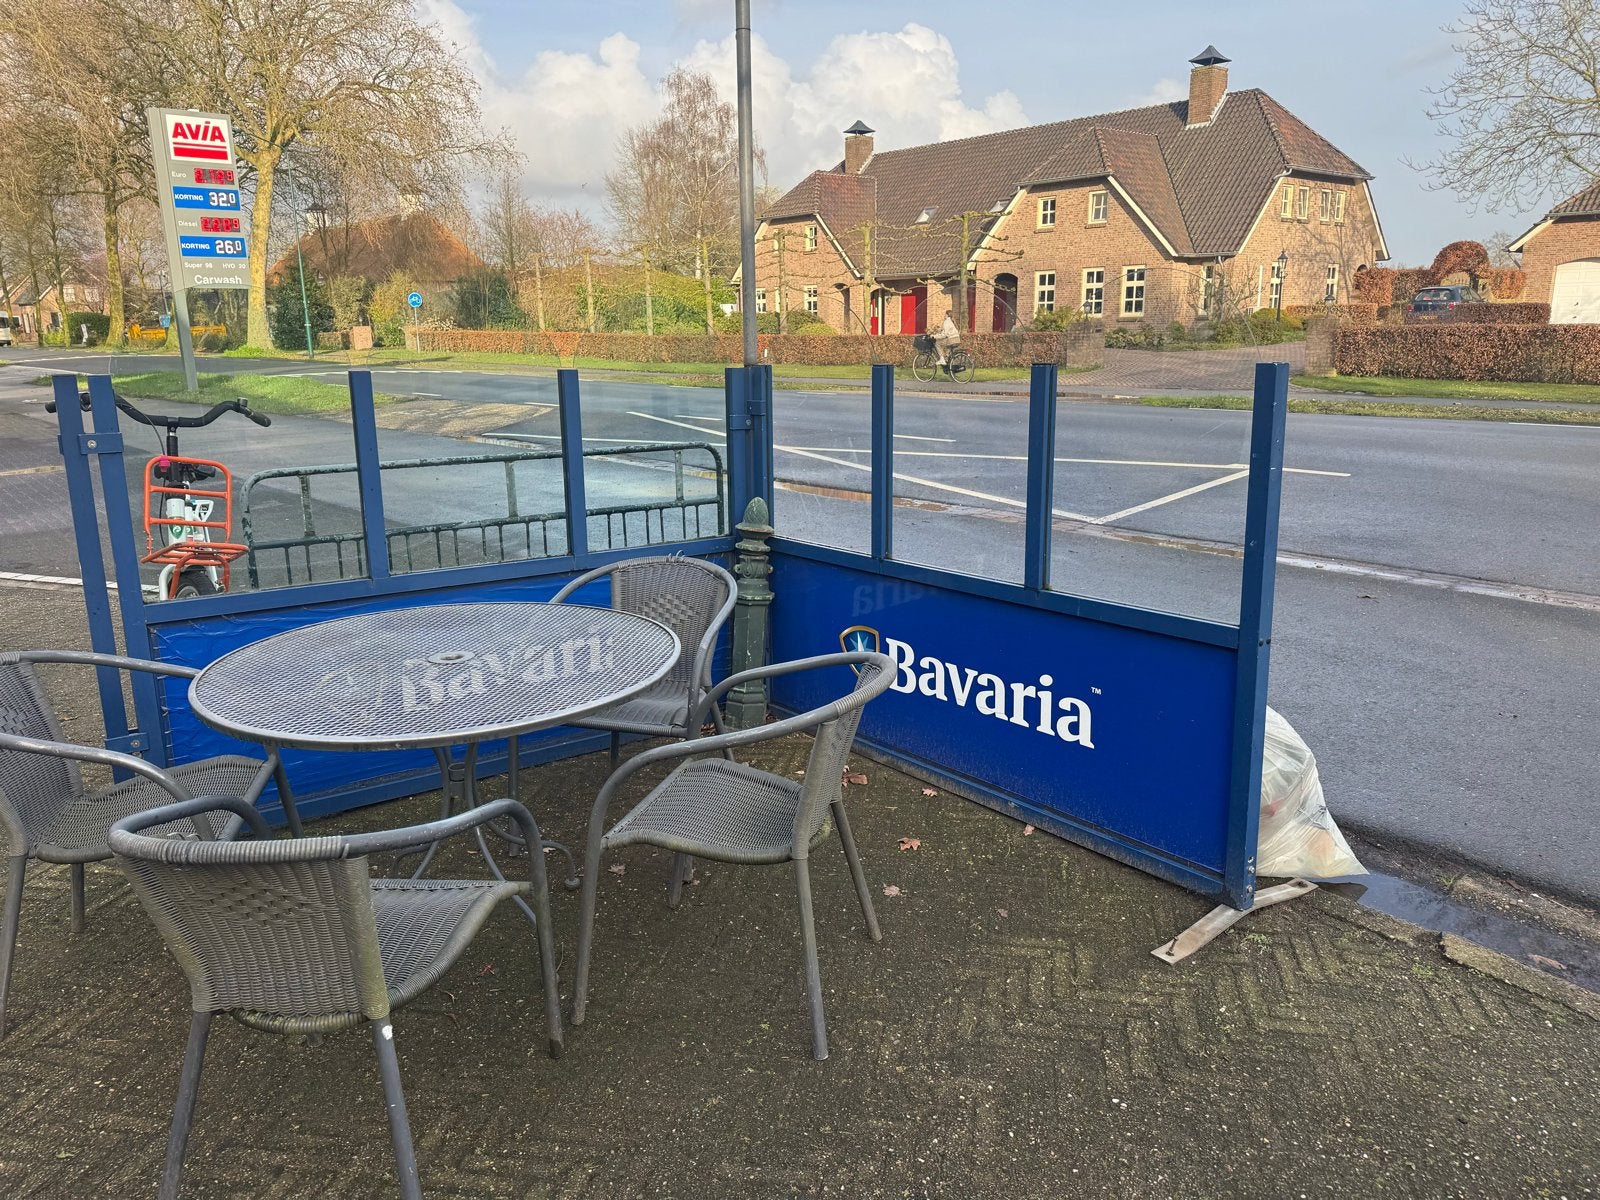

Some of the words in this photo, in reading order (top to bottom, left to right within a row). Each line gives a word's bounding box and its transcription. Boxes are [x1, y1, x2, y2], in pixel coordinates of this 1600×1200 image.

[174, 193, 204, 201] KORTING
[181, 242, 210, 250] KORTING
[194, 274, 242, 285] Carwash
[885, 637, 1095, 749] Bavaria
